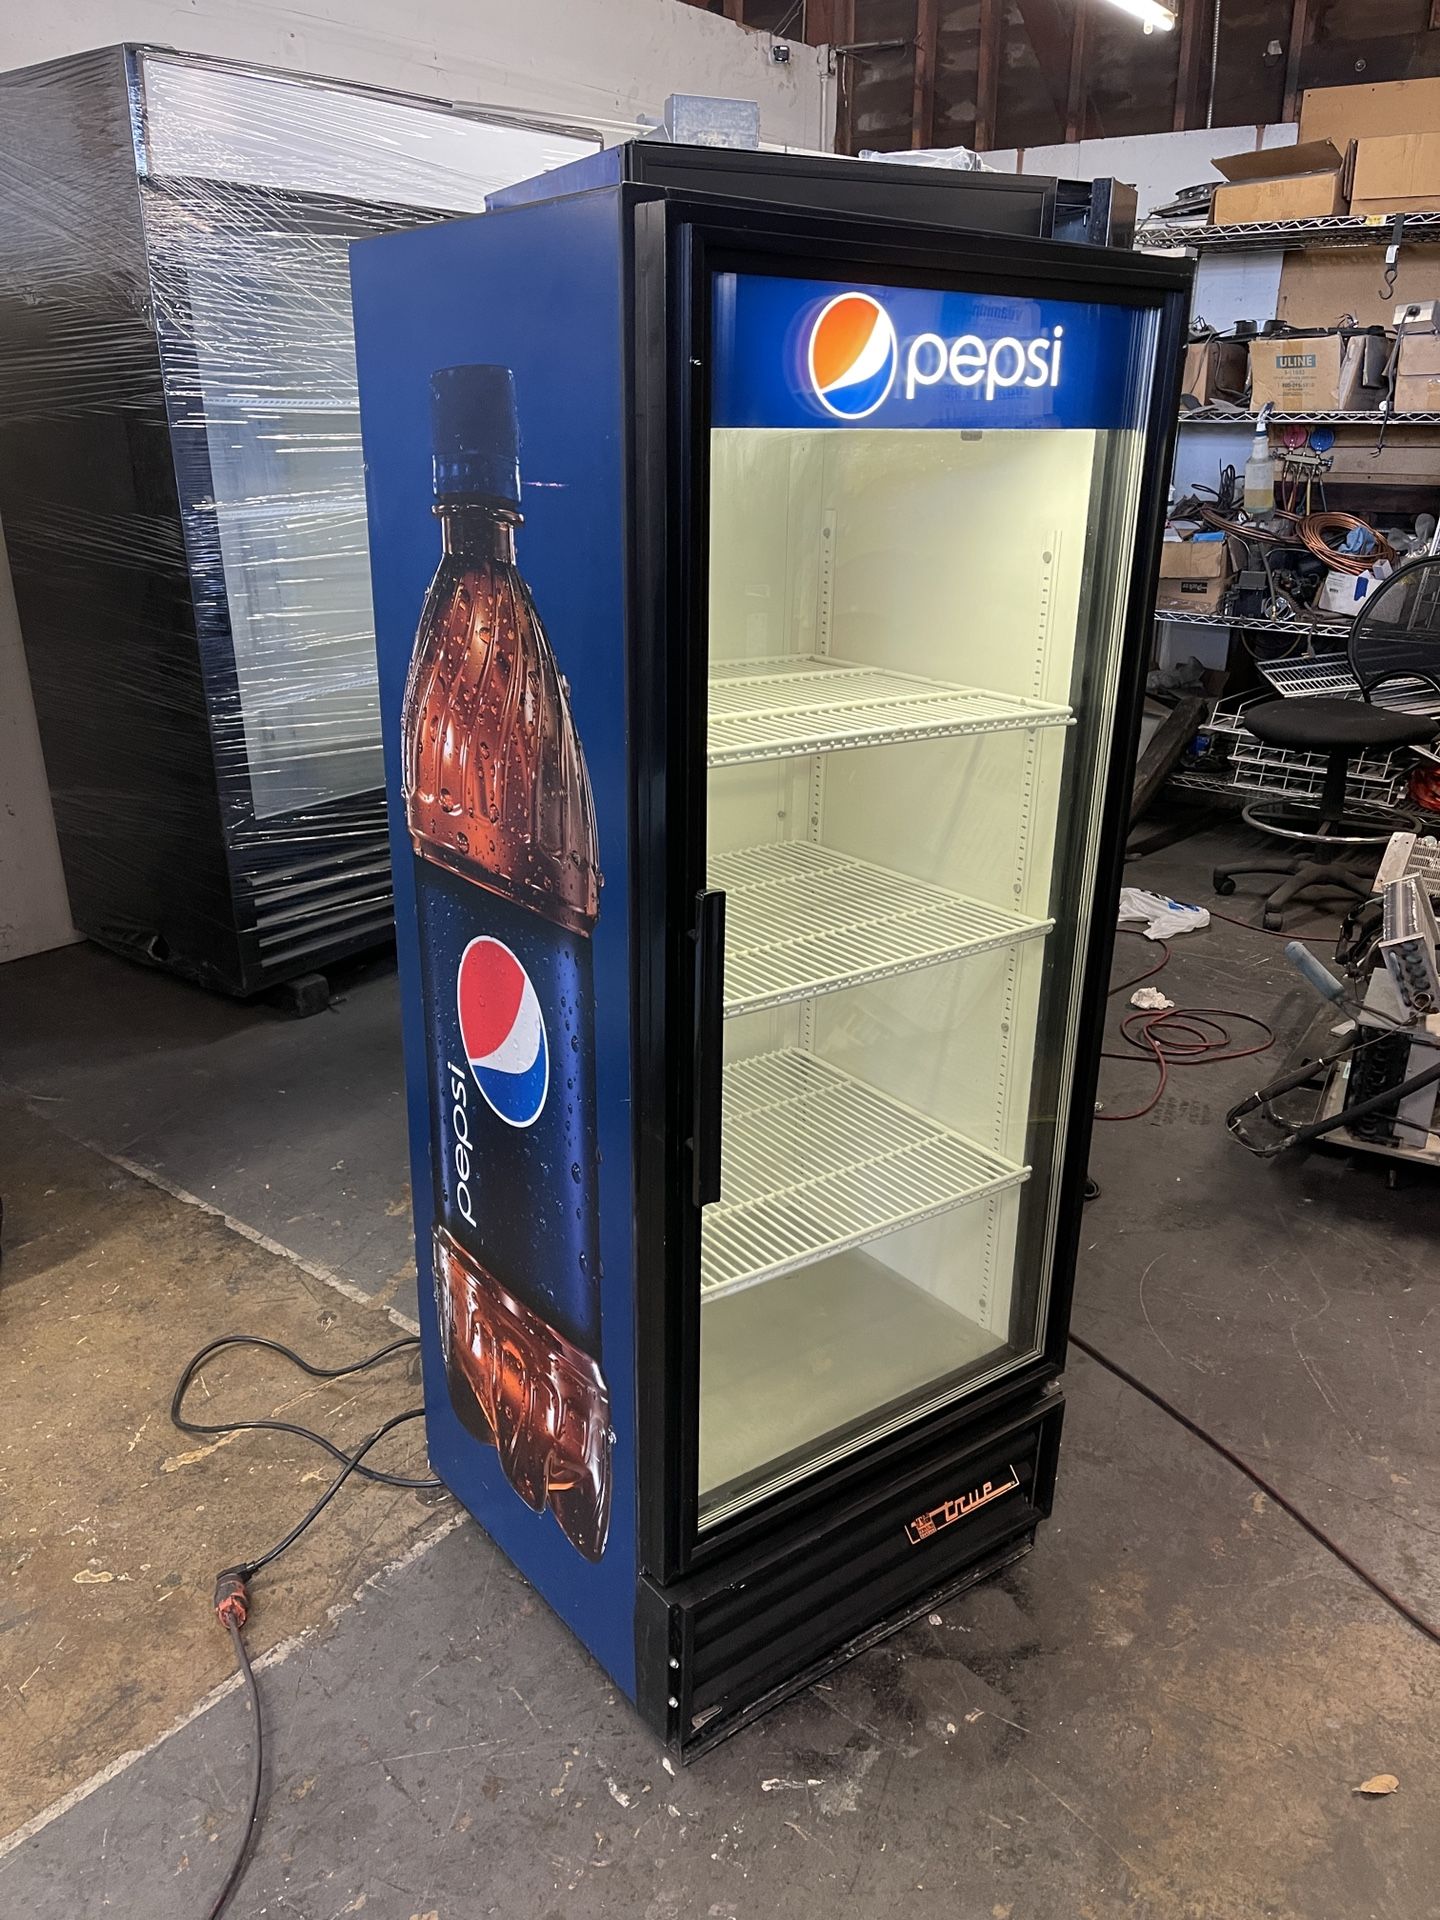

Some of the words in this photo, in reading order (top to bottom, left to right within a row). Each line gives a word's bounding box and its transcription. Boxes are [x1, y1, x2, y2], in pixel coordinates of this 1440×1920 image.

[905, 325, 1064, 400] pepsi
[1279, 356, 1313, 368] ULINE
[447, 1061, 477, 1228] pepsi
